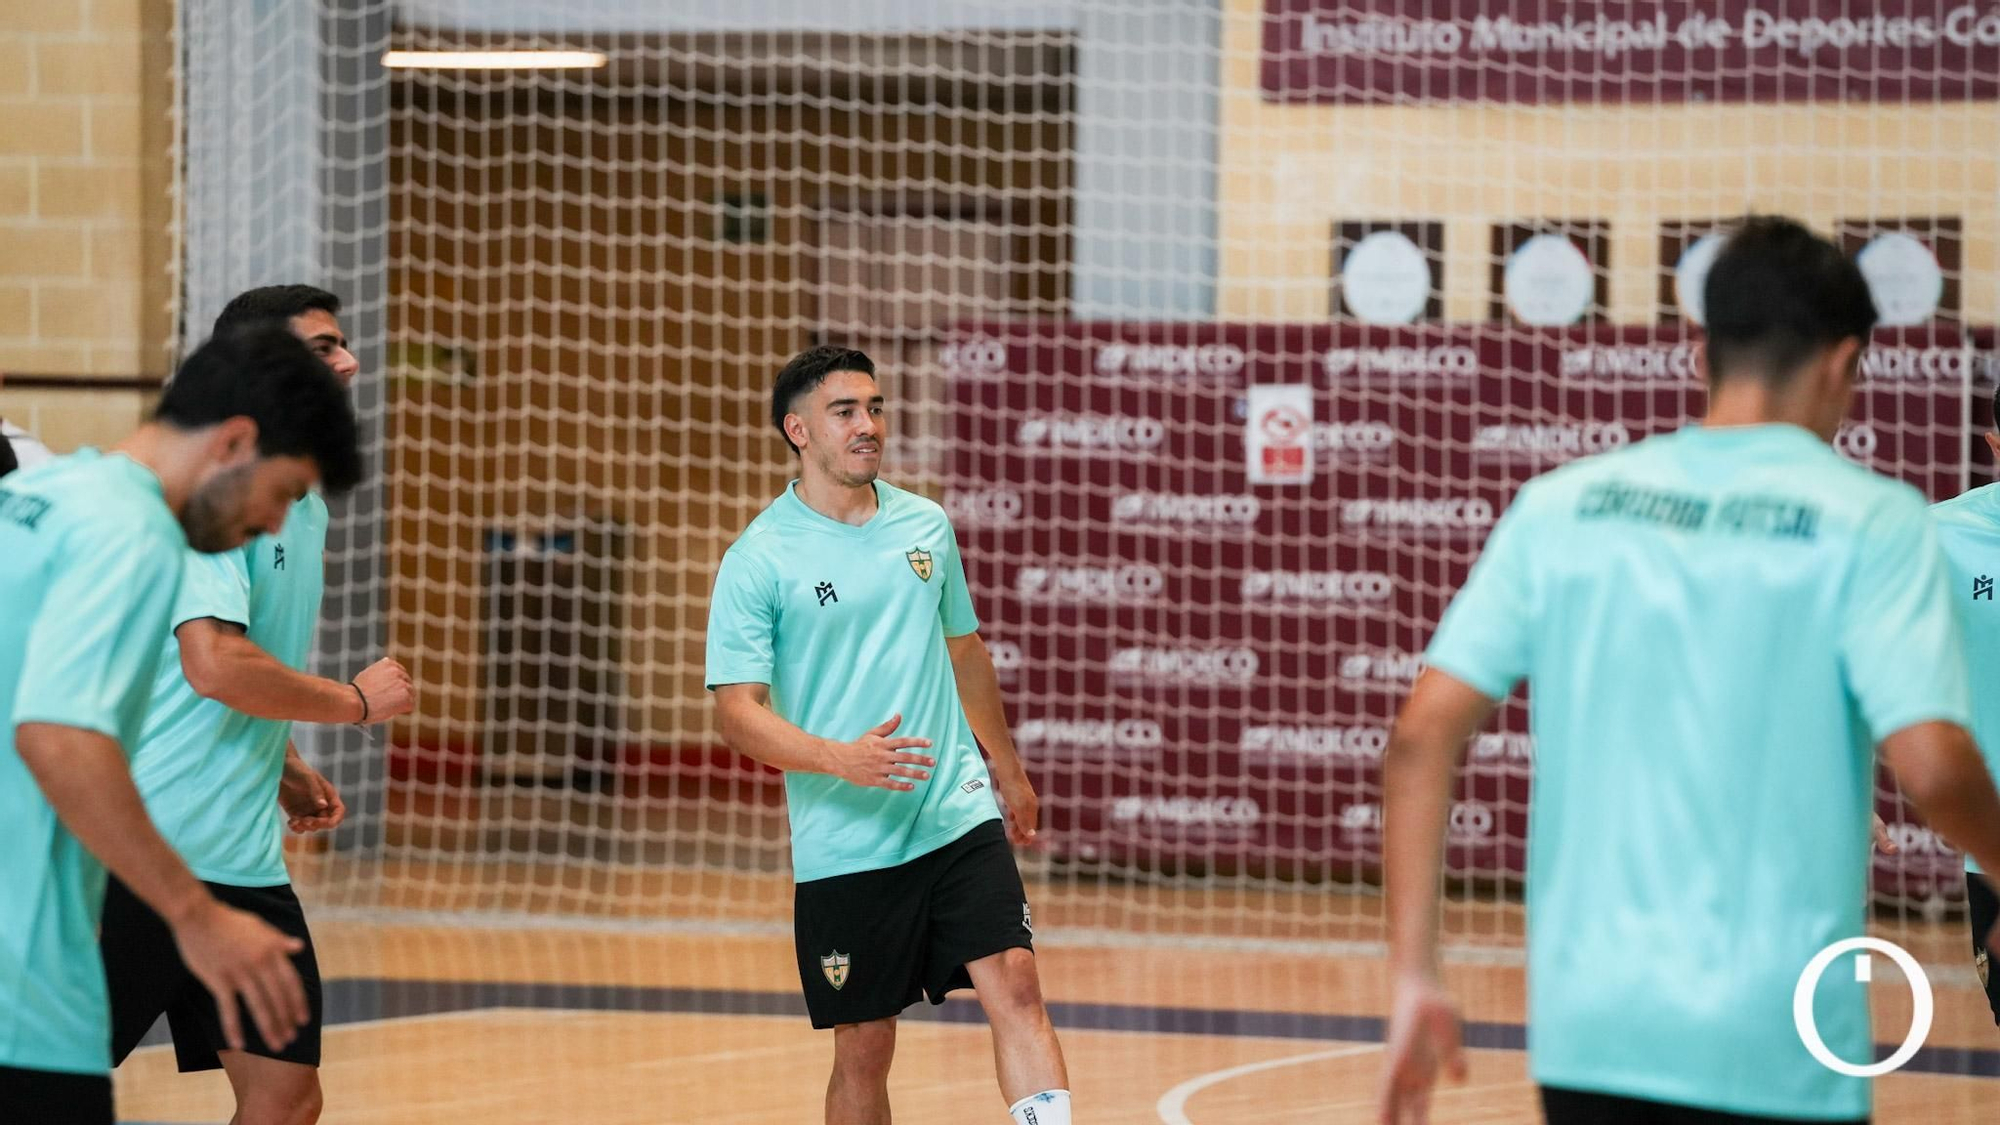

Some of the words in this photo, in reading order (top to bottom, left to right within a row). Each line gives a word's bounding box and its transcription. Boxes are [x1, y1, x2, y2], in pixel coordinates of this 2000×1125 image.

[1302, 14, 1461, 52] Instituto
[1471, 12, 1667, 60] Municipal
[1677, 12, 1731, 49] de
[1743, 8, 1933, 58] Deportes
